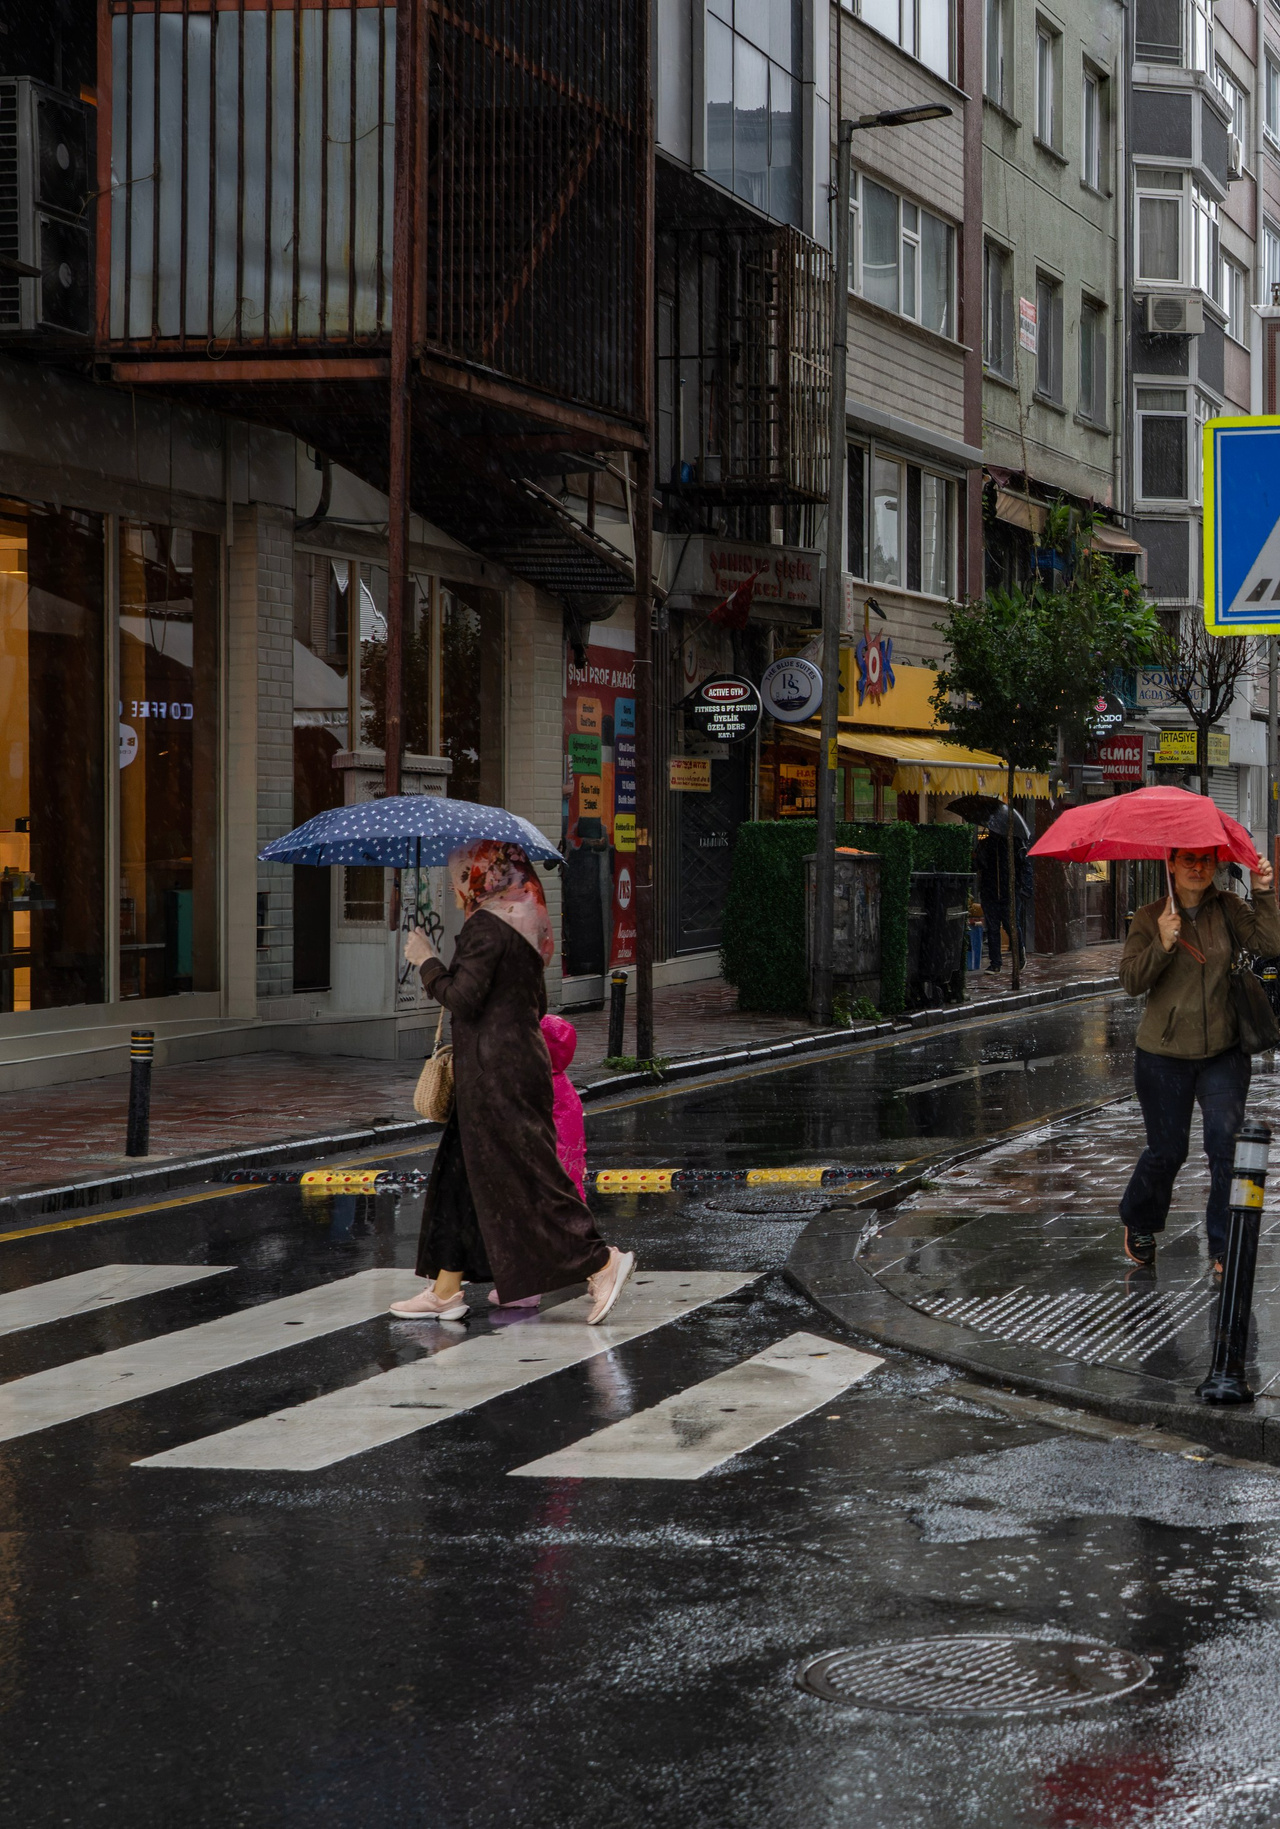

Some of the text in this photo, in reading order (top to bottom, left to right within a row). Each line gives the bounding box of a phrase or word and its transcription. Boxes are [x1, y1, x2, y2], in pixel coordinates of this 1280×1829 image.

[589, 666, 610, 685] PROF
[765, 660, 817, 681] THE BLUE SUITES
[708, 687, 744, 697] ACTIVE GYM
[1139, 688, 1163, 700] AĞDA
[735, 704, 758, 712] STUDIO
[713, 713, 739, 722] ÜYELİK
[707, 722, 746, 731] ÖZEL DERS
[1100, 747, 1141, 761] ELMAS
